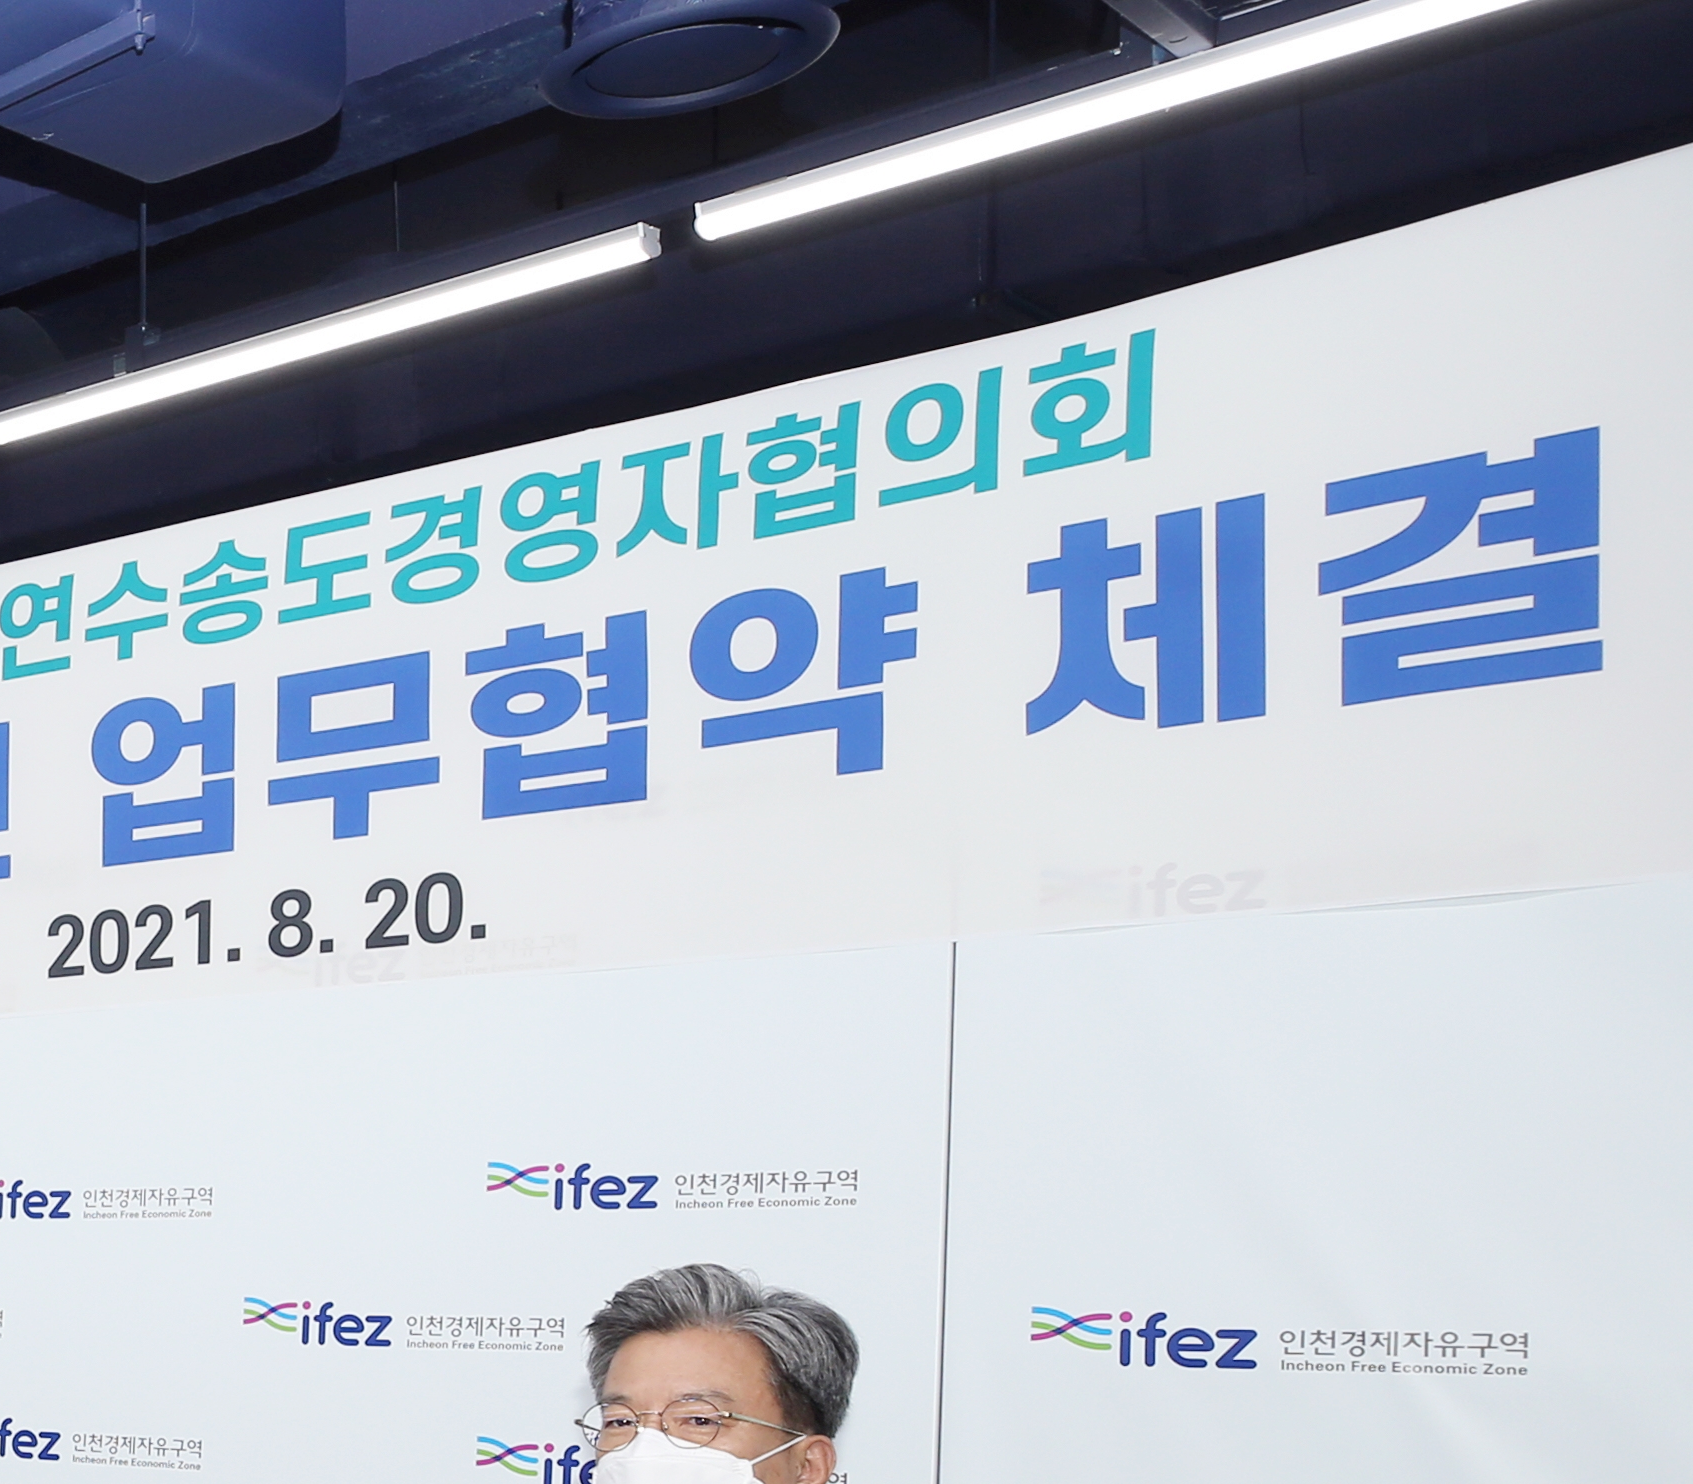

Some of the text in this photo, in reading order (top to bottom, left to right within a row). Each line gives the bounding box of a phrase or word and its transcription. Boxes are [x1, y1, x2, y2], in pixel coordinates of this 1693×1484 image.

[90, 565, 919, 869] 업무협약
[1025, 425, 1603, 736] 체결
[46, 899, 240, 979] 2021.
[268, 888, 334, 958] 8.
[364, 871, 487, 950] 20.
[554, 1162, 659, 1211] ifez
[675, 1168, 859, 1197] 인천경제자유구역
[82, 1186, 214, 1209] 인천경제자유구역
[675, 1196, 857, 1210] Incheon Free Economic Zone
[82, 1209, 212, 1219] Incheon Free Economic Zone
[301, 1301, 393, 1347] ifez
[406, 1315, 566, 1339] 인천경제자유구역
[406, 1339, 564, 1352] Incheon Free Economic Zone
[1118, 1309, 1258, 1369] ifez
[1278, 1328, 1530, 1360] 인천경제자유구역
[1280, 1359, 1529, 1377] Incheon Free Economic Zone
[72, 1432, 203, 1459] 인천경제자유구역
[72, 1454, 202, 1471] Incheon Free Economic Zone
